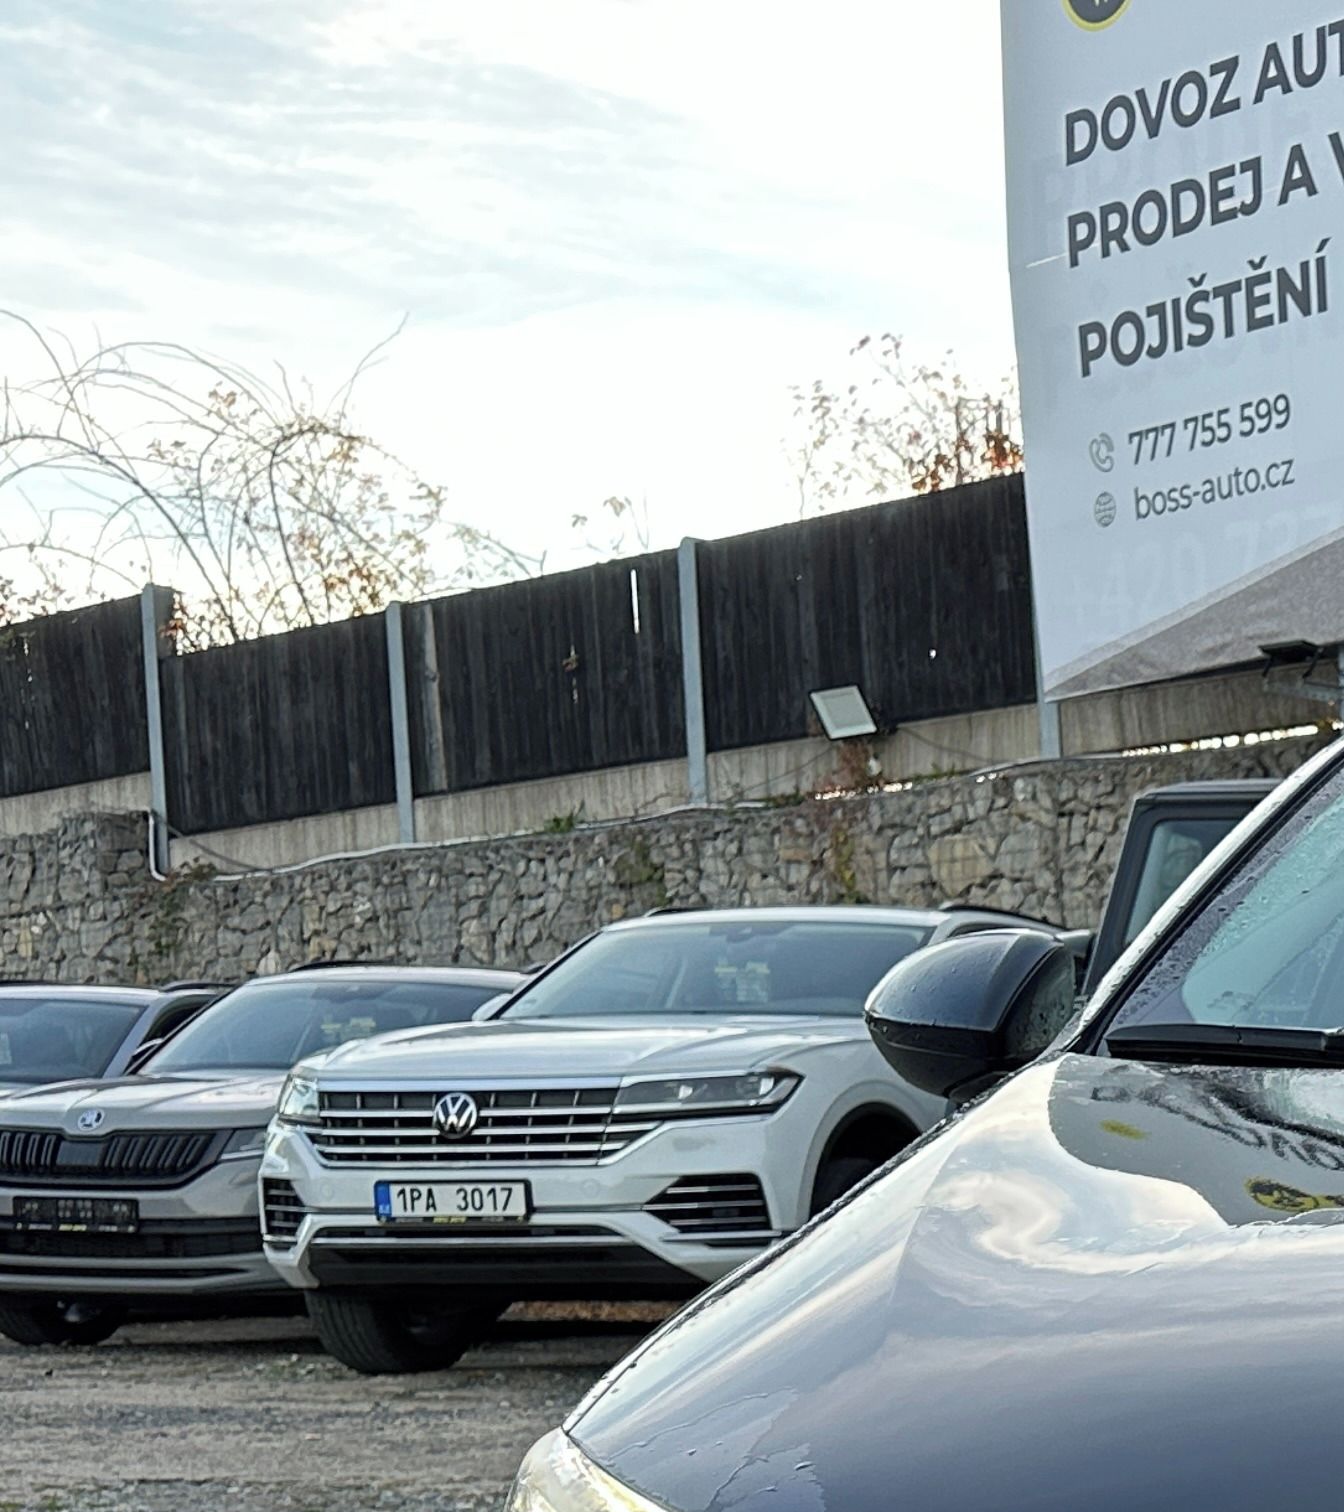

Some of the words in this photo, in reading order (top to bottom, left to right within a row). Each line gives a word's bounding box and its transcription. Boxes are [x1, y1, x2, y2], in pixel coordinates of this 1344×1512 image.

[1065, 54, 1241, 167] DOVOZ
[1067, 156, 1263, 269] PRODEJ
[1277, 143, 1319, 206] A
[1078, 237, 1331, 378] POJIŠTĚNÍ
[1128, 421, 1177, 465] 777
[1183, 407, 1232, 451] 755
[1239, 393, 1291, 438] 599
[1134, 458, 1295, 521] boss-auto.cz
[397, 1187, 437, 1212] 1PA
[456, 1187, 513, 1212] 3017
